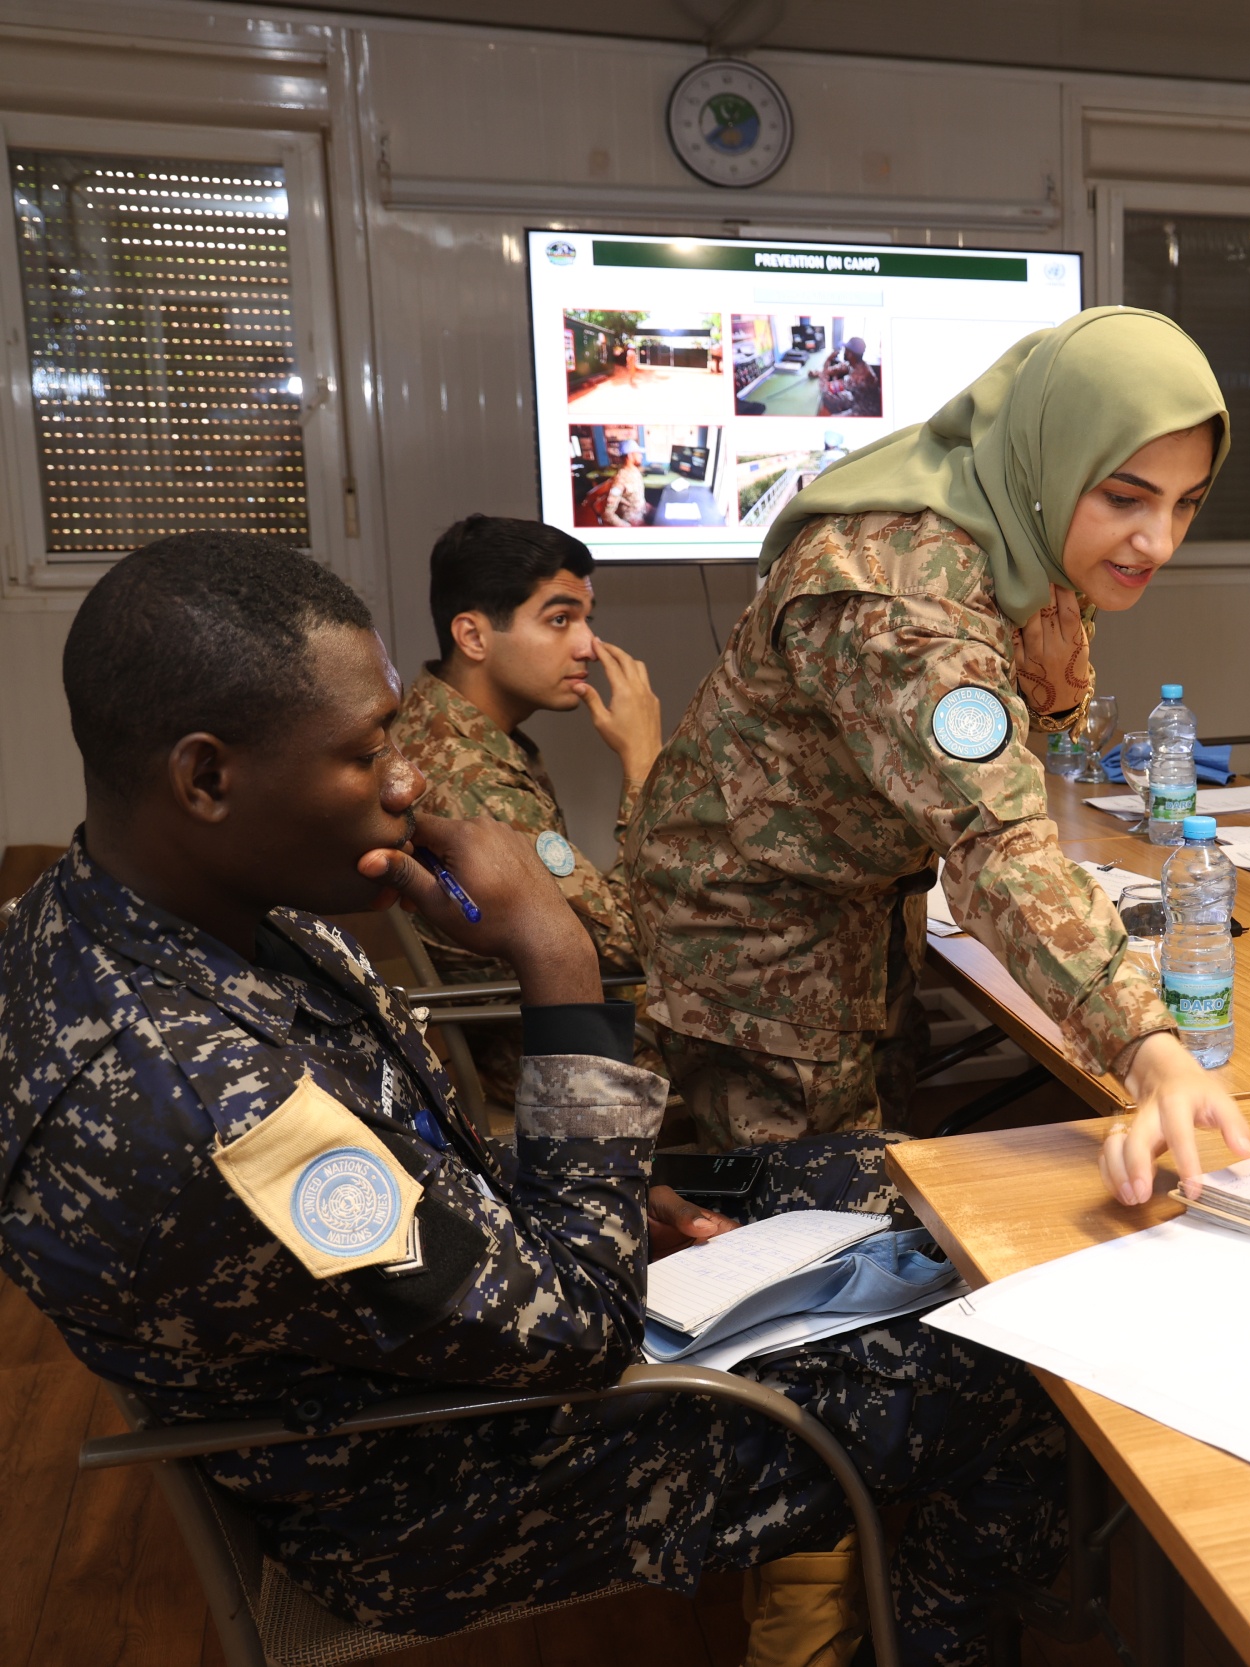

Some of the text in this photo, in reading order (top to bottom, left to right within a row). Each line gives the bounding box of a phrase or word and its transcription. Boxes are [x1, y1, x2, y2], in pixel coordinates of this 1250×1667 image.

[755, 252, 824, 269] PREVENTION
[843, 256, 880, 273] CAMP)
[943, 690, 1003, 719] UNITED NATIONS
[938, 727, 998, 755] NATIONS UNIES
[1165, 800, 1192, 810] DARO
[1180, 998, 1225, 1012] DARO
[303, 1160, 370, 1215] UNITED NATIONS
[327, 1193, 388, 1244] NATIONS UNIES
